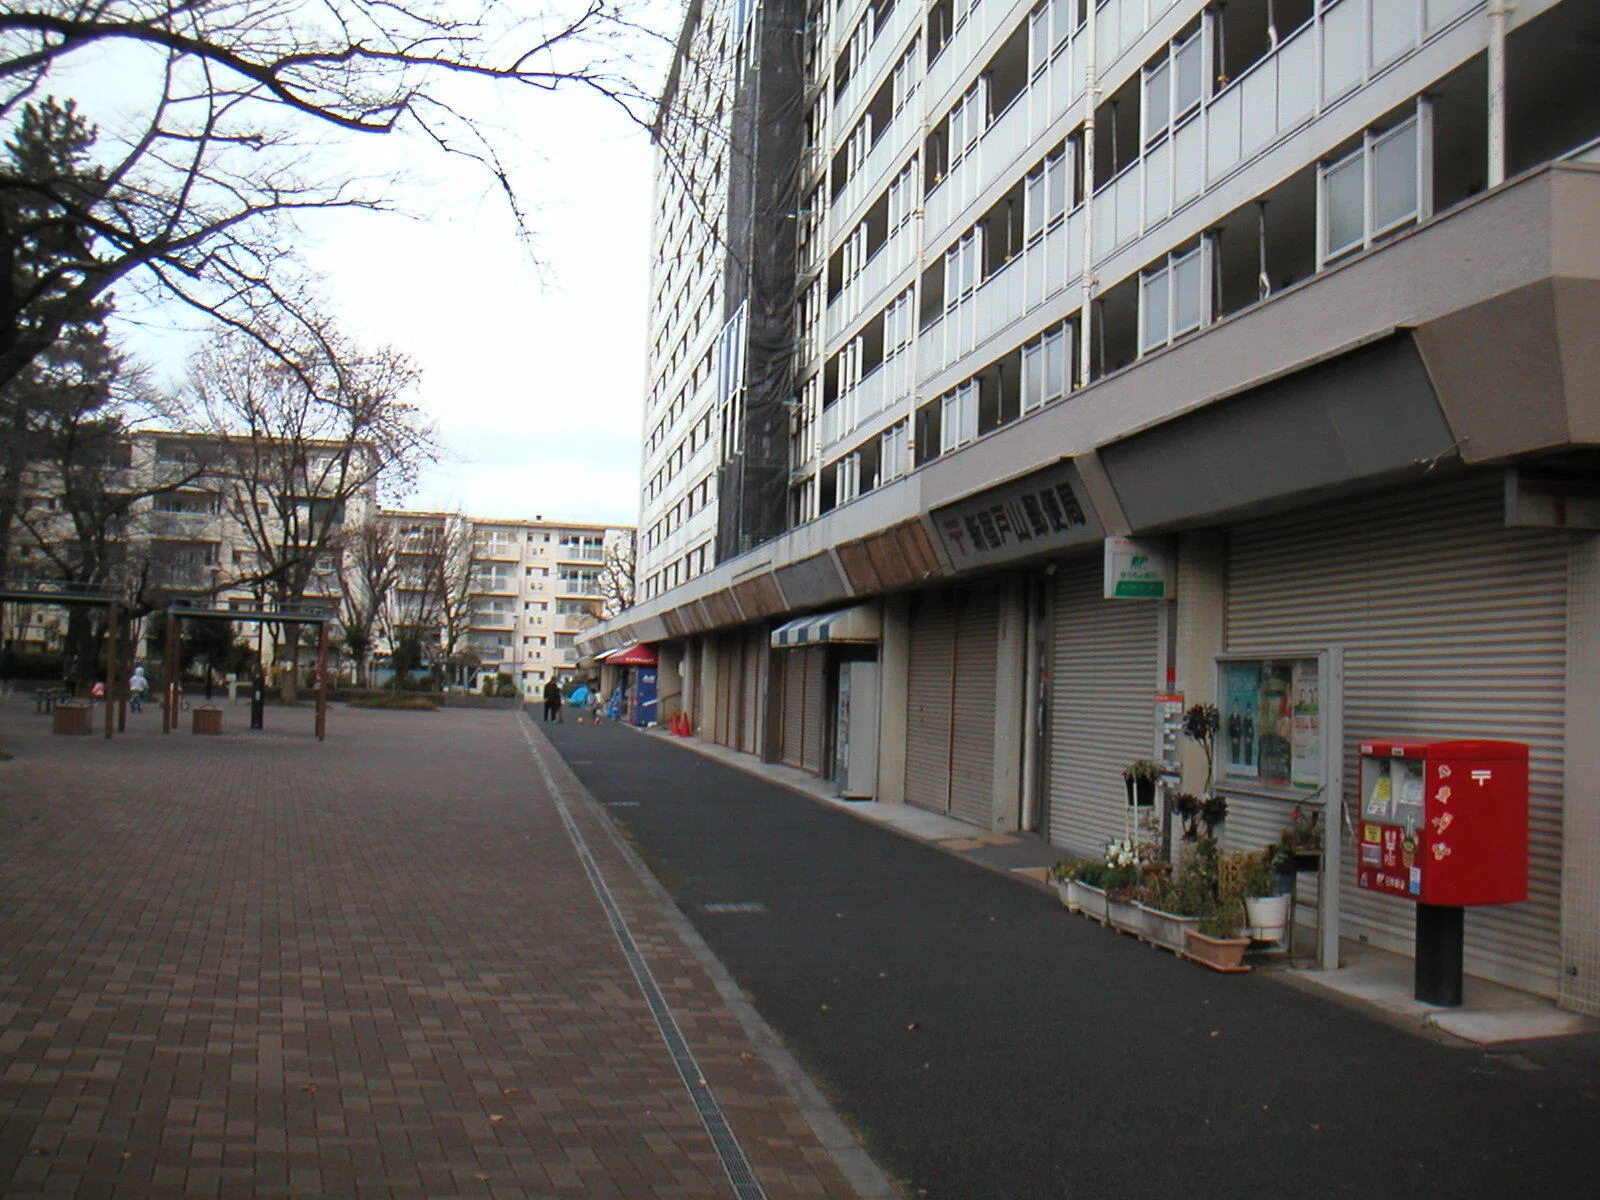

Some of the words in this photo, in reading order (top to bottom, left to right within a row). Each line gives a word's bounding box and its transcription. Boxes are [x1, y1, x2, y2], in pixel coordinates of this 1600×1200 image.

[964, 482, 1086, 553] 新宿戸山郵便局
